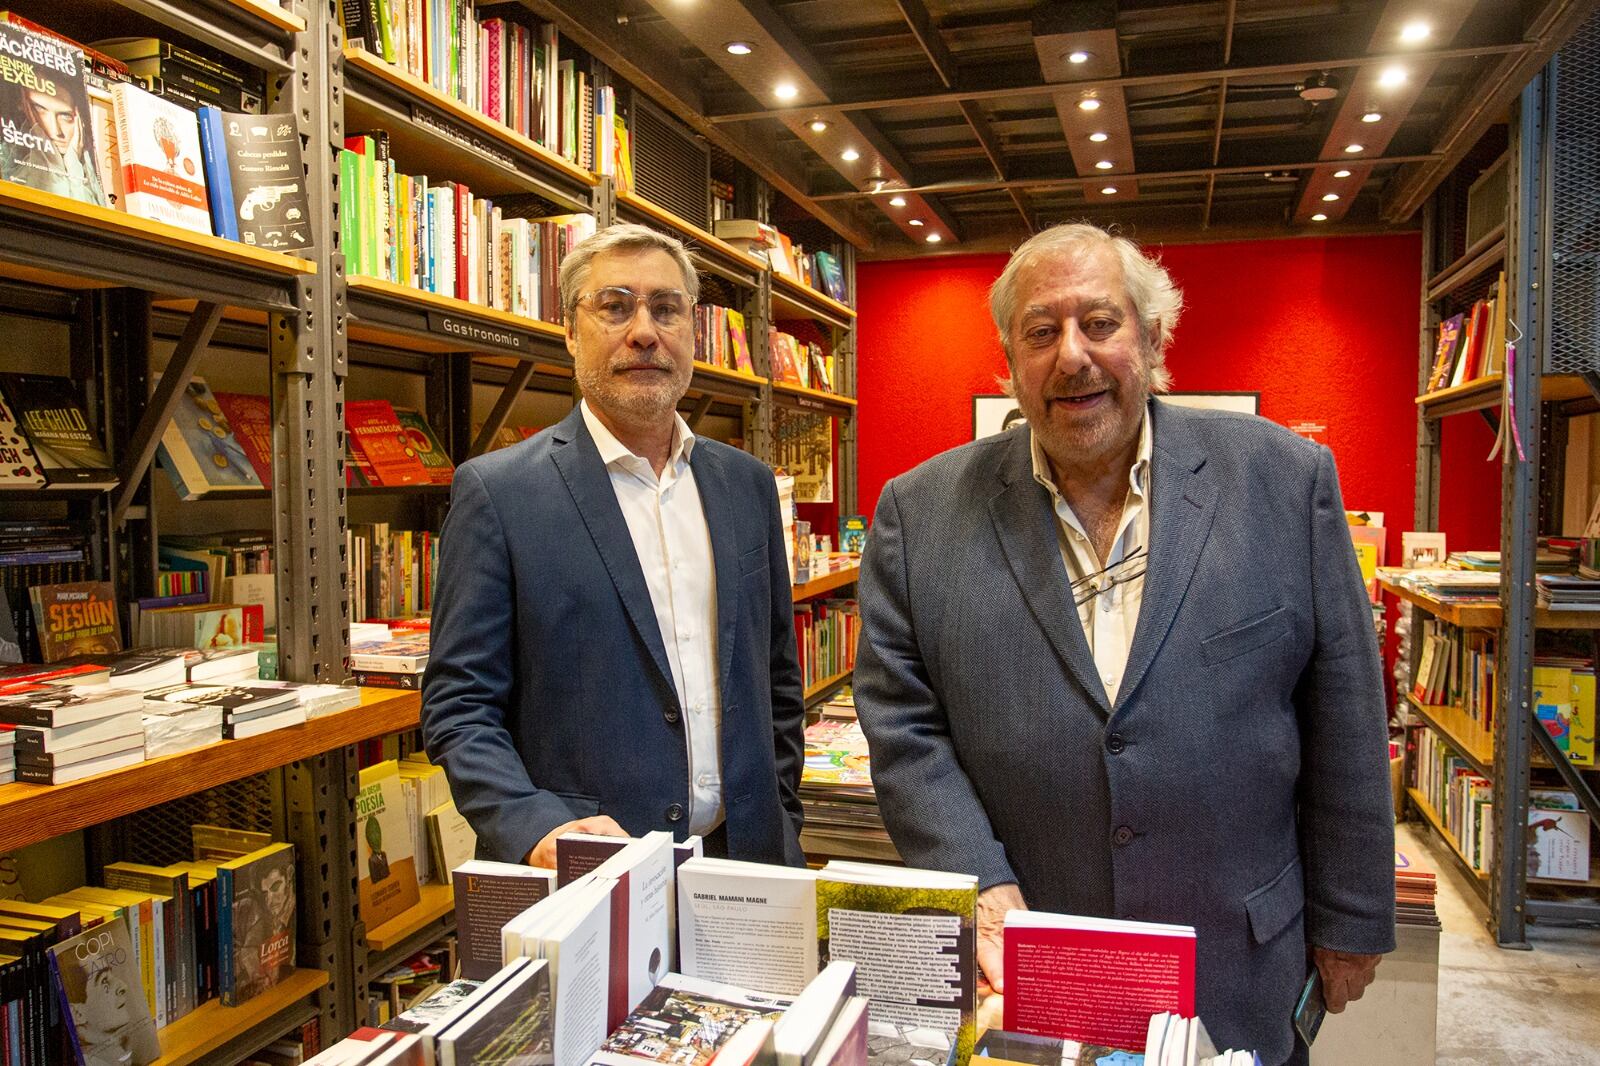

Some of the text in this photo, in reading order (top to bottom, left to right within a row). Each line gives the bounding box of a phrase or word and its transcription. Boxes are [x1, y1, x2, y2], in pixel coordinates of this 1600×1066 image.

[0, 32, 76, 77] ÄCKBERG
[24, 35, 73, 63] CAMILLA
[0, 54, 36, 76] ENRIK
[1, 116, 16, 131] LA
[2, 128, 56, 155] SECTA
[262, 150, 288, 159] perdidas
[24, 408, 87, 430] LEE CHILD
[49, 594, 114, 632] SESIÓN
[694, 892, 717, 901] GABRIEL
[75, 930, 114, 961] COPI
[260, 934, 289, 958] Lorca
